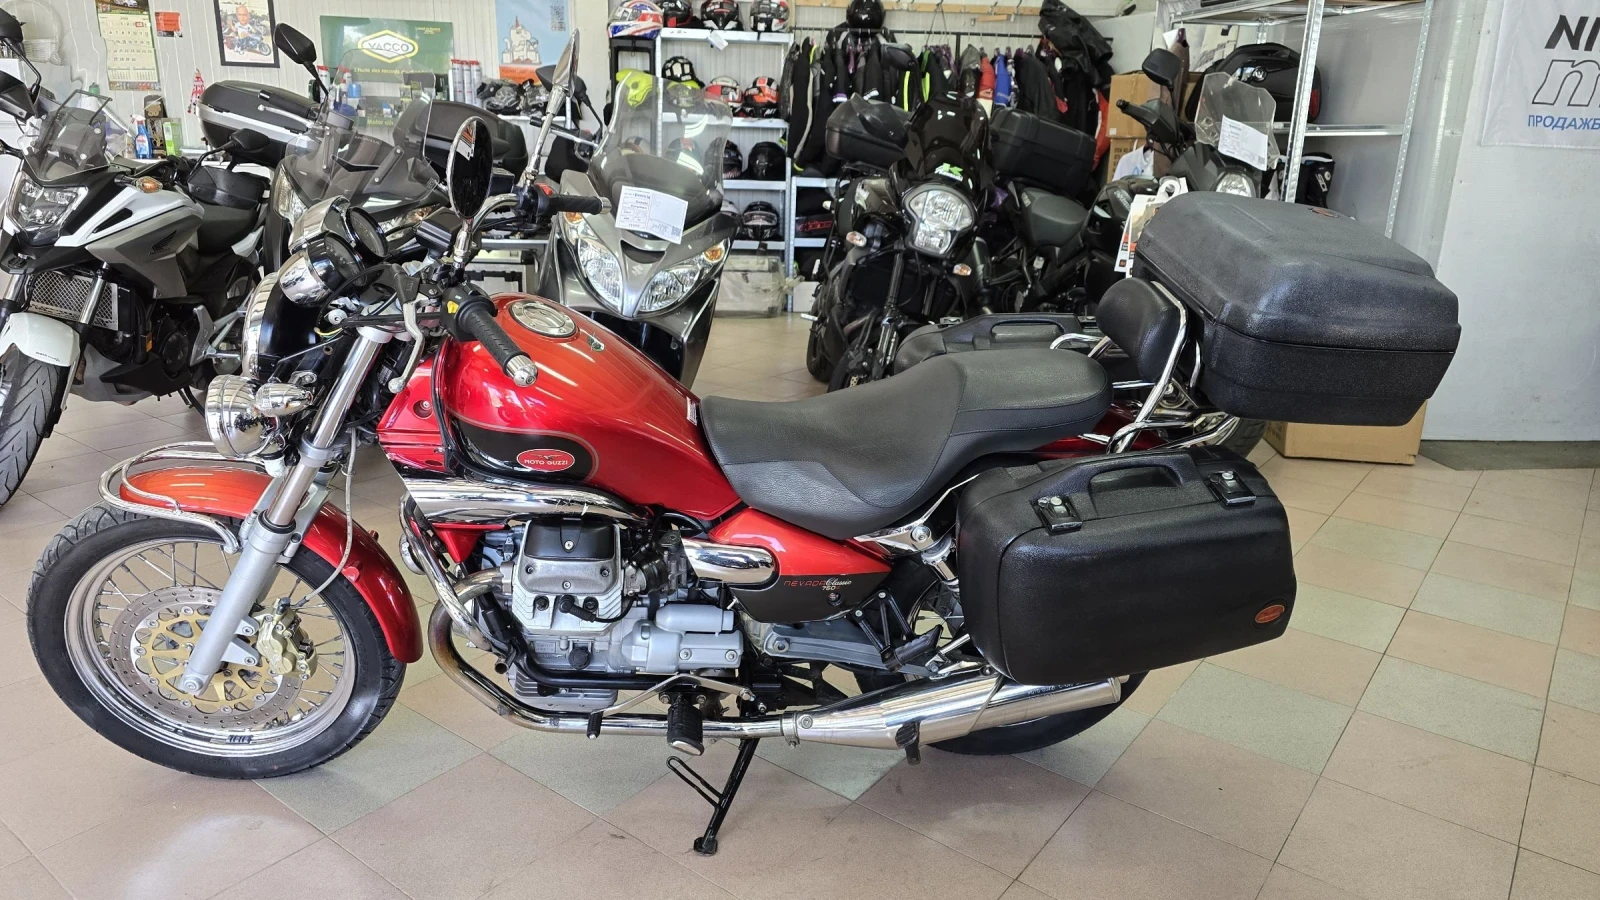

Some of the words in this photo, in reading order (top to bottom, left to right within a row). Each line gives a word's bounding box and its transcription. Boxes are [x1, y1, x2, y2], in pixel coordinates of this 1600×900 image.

[1544, 14, 1600, 52] NI
[368, 42, 410, 52] YACCO
[826, 577, 852, 586] Classic
